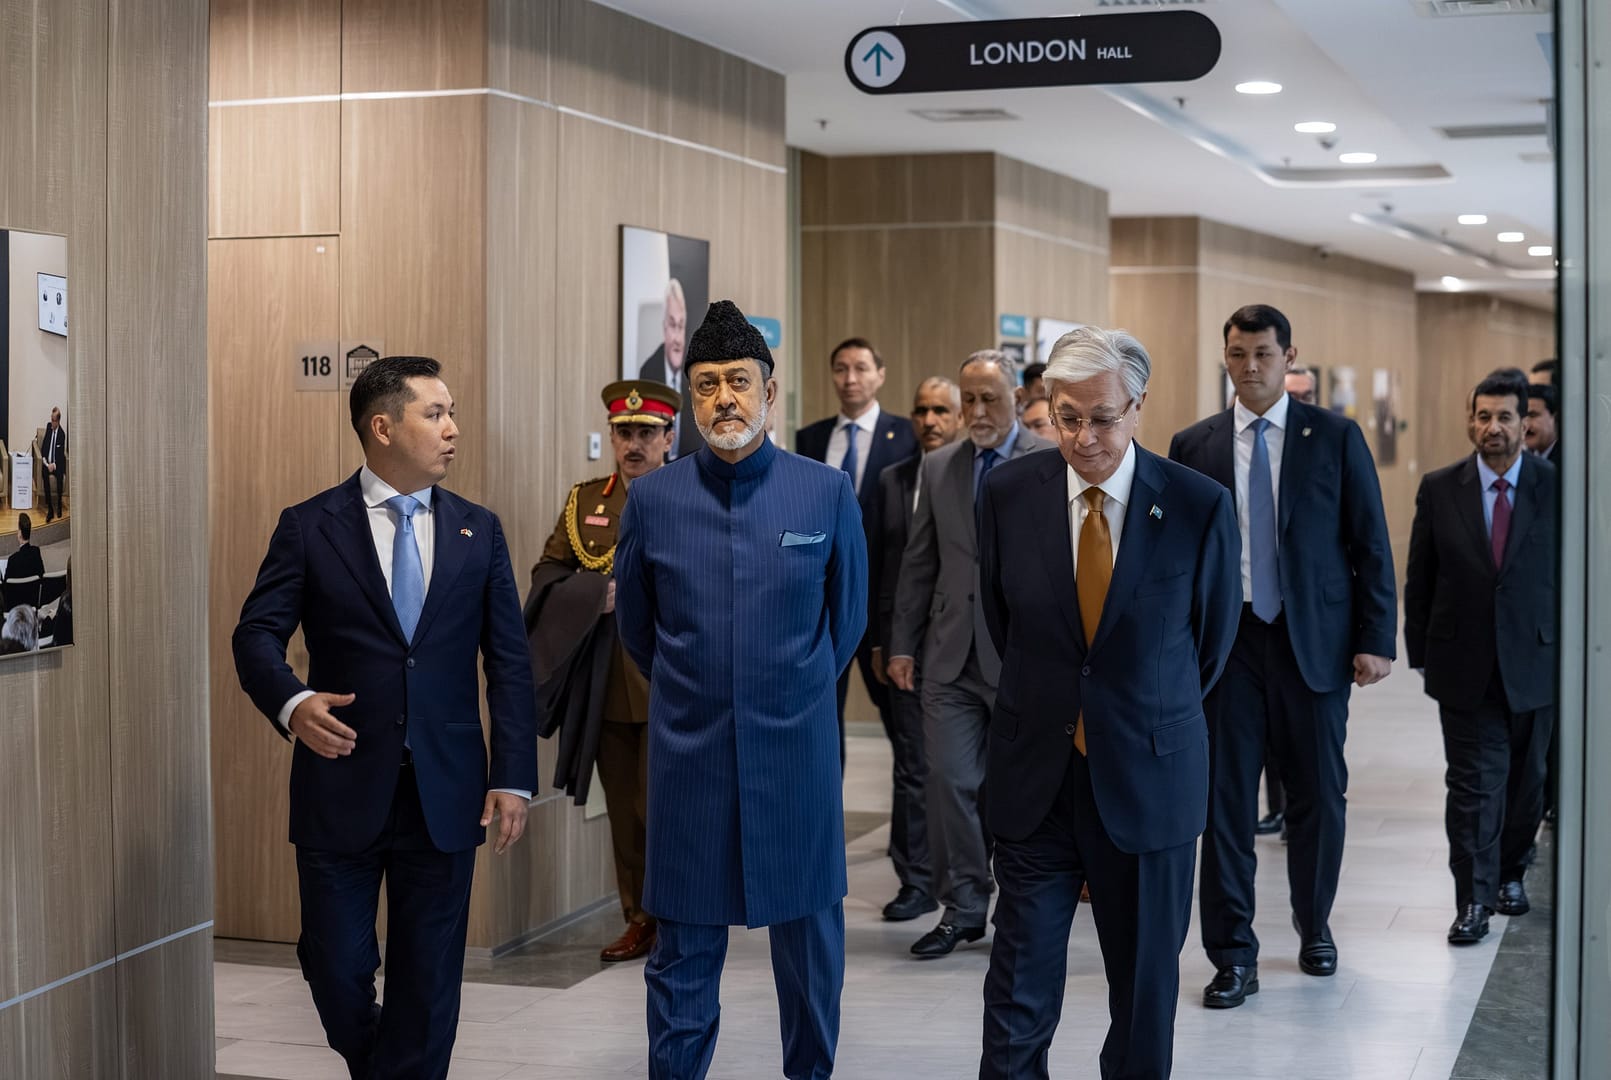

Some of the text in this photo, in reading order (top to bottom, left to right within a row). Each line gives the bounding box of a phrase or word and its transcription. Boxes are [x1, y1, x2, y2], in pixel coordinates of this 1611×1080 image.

[970, 39, 1132, 66] LONDON HALL
[302, 356, 331, 376] 118
